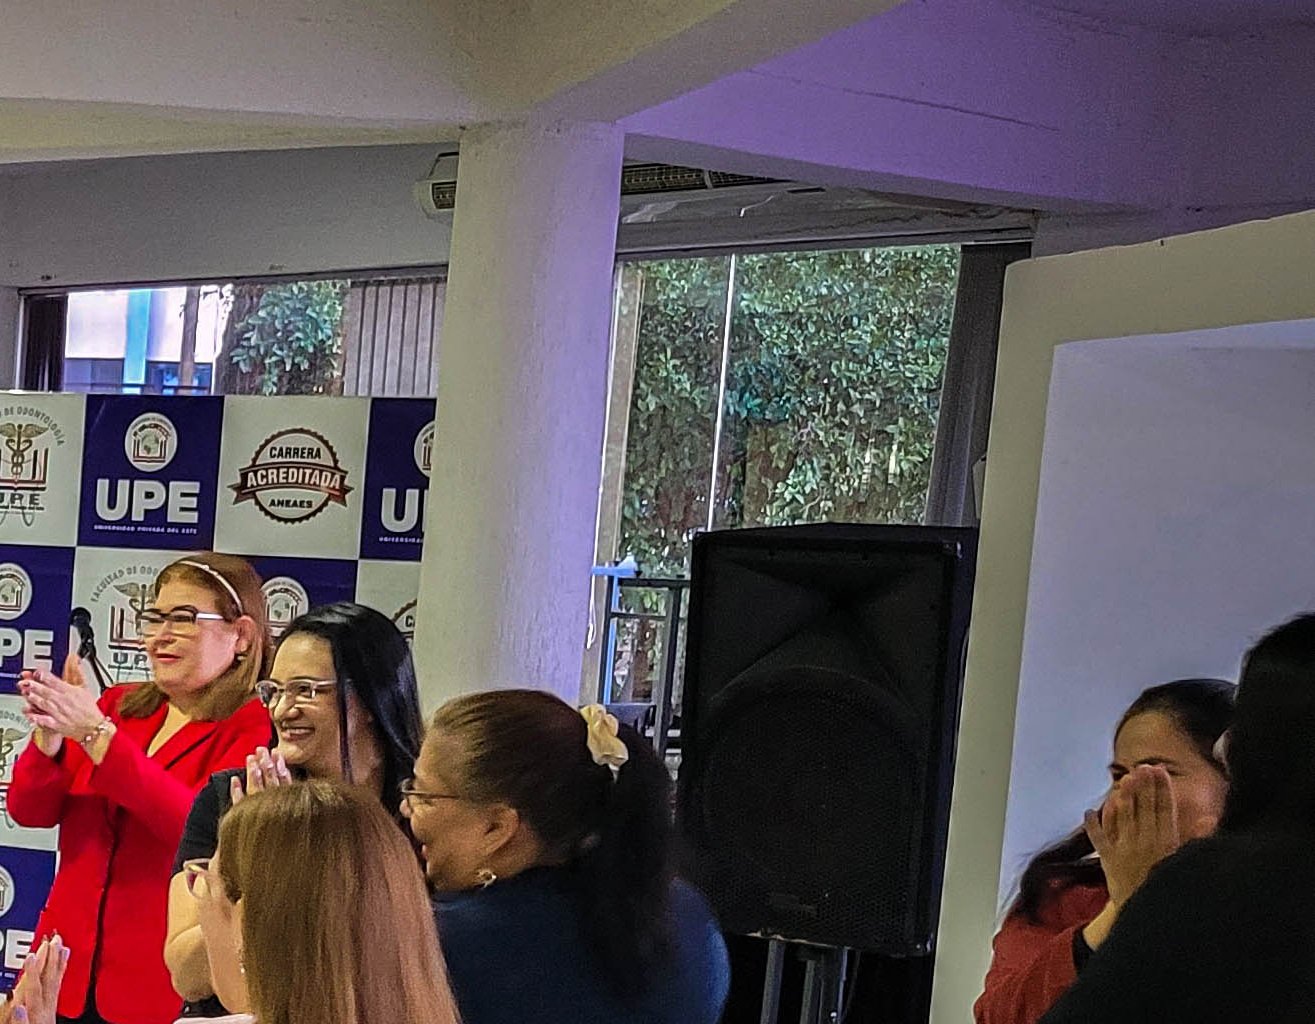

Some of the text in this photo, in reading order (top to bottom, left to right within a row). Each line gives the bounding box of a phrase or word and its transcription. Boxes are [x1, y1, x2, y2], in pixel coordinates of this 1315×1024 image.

[4, 406, 15, 416] DE
[269, 447, 322, 460] CARRERA
[247, 468, 342, 490] ACREDITADA
[95, 478, 201, 524] UPE
[269, 499, 313, 509] ANEAES
[113, 652, 148, 666] UP
